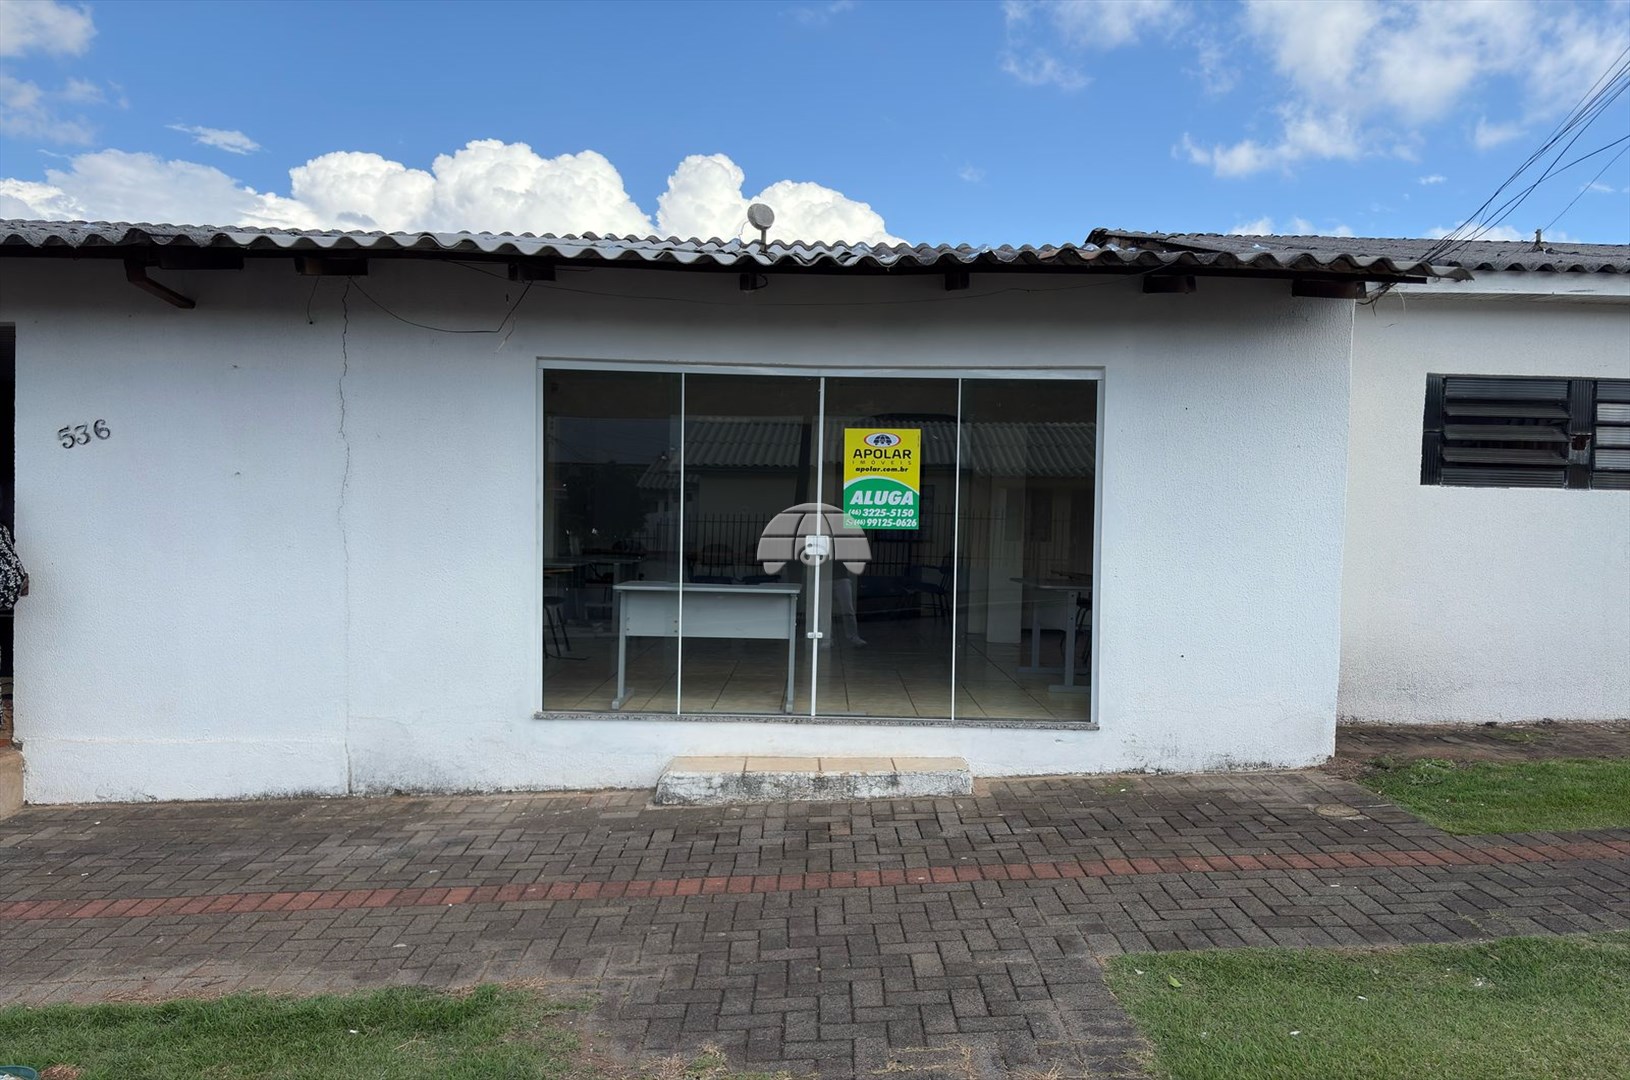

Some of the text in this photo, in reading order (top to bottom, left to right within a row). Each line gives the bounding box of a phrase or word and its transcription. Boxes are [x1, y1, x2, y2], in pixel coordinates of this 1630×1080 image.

[57, 419, 111, 449] 536
[853, 449, 911, 459] APOLAR
[850, 490, 914, 505] ALUGA
[862, 509, 914, 517] 3225-5150
[867, 519, 917, 527] 99125-0626
